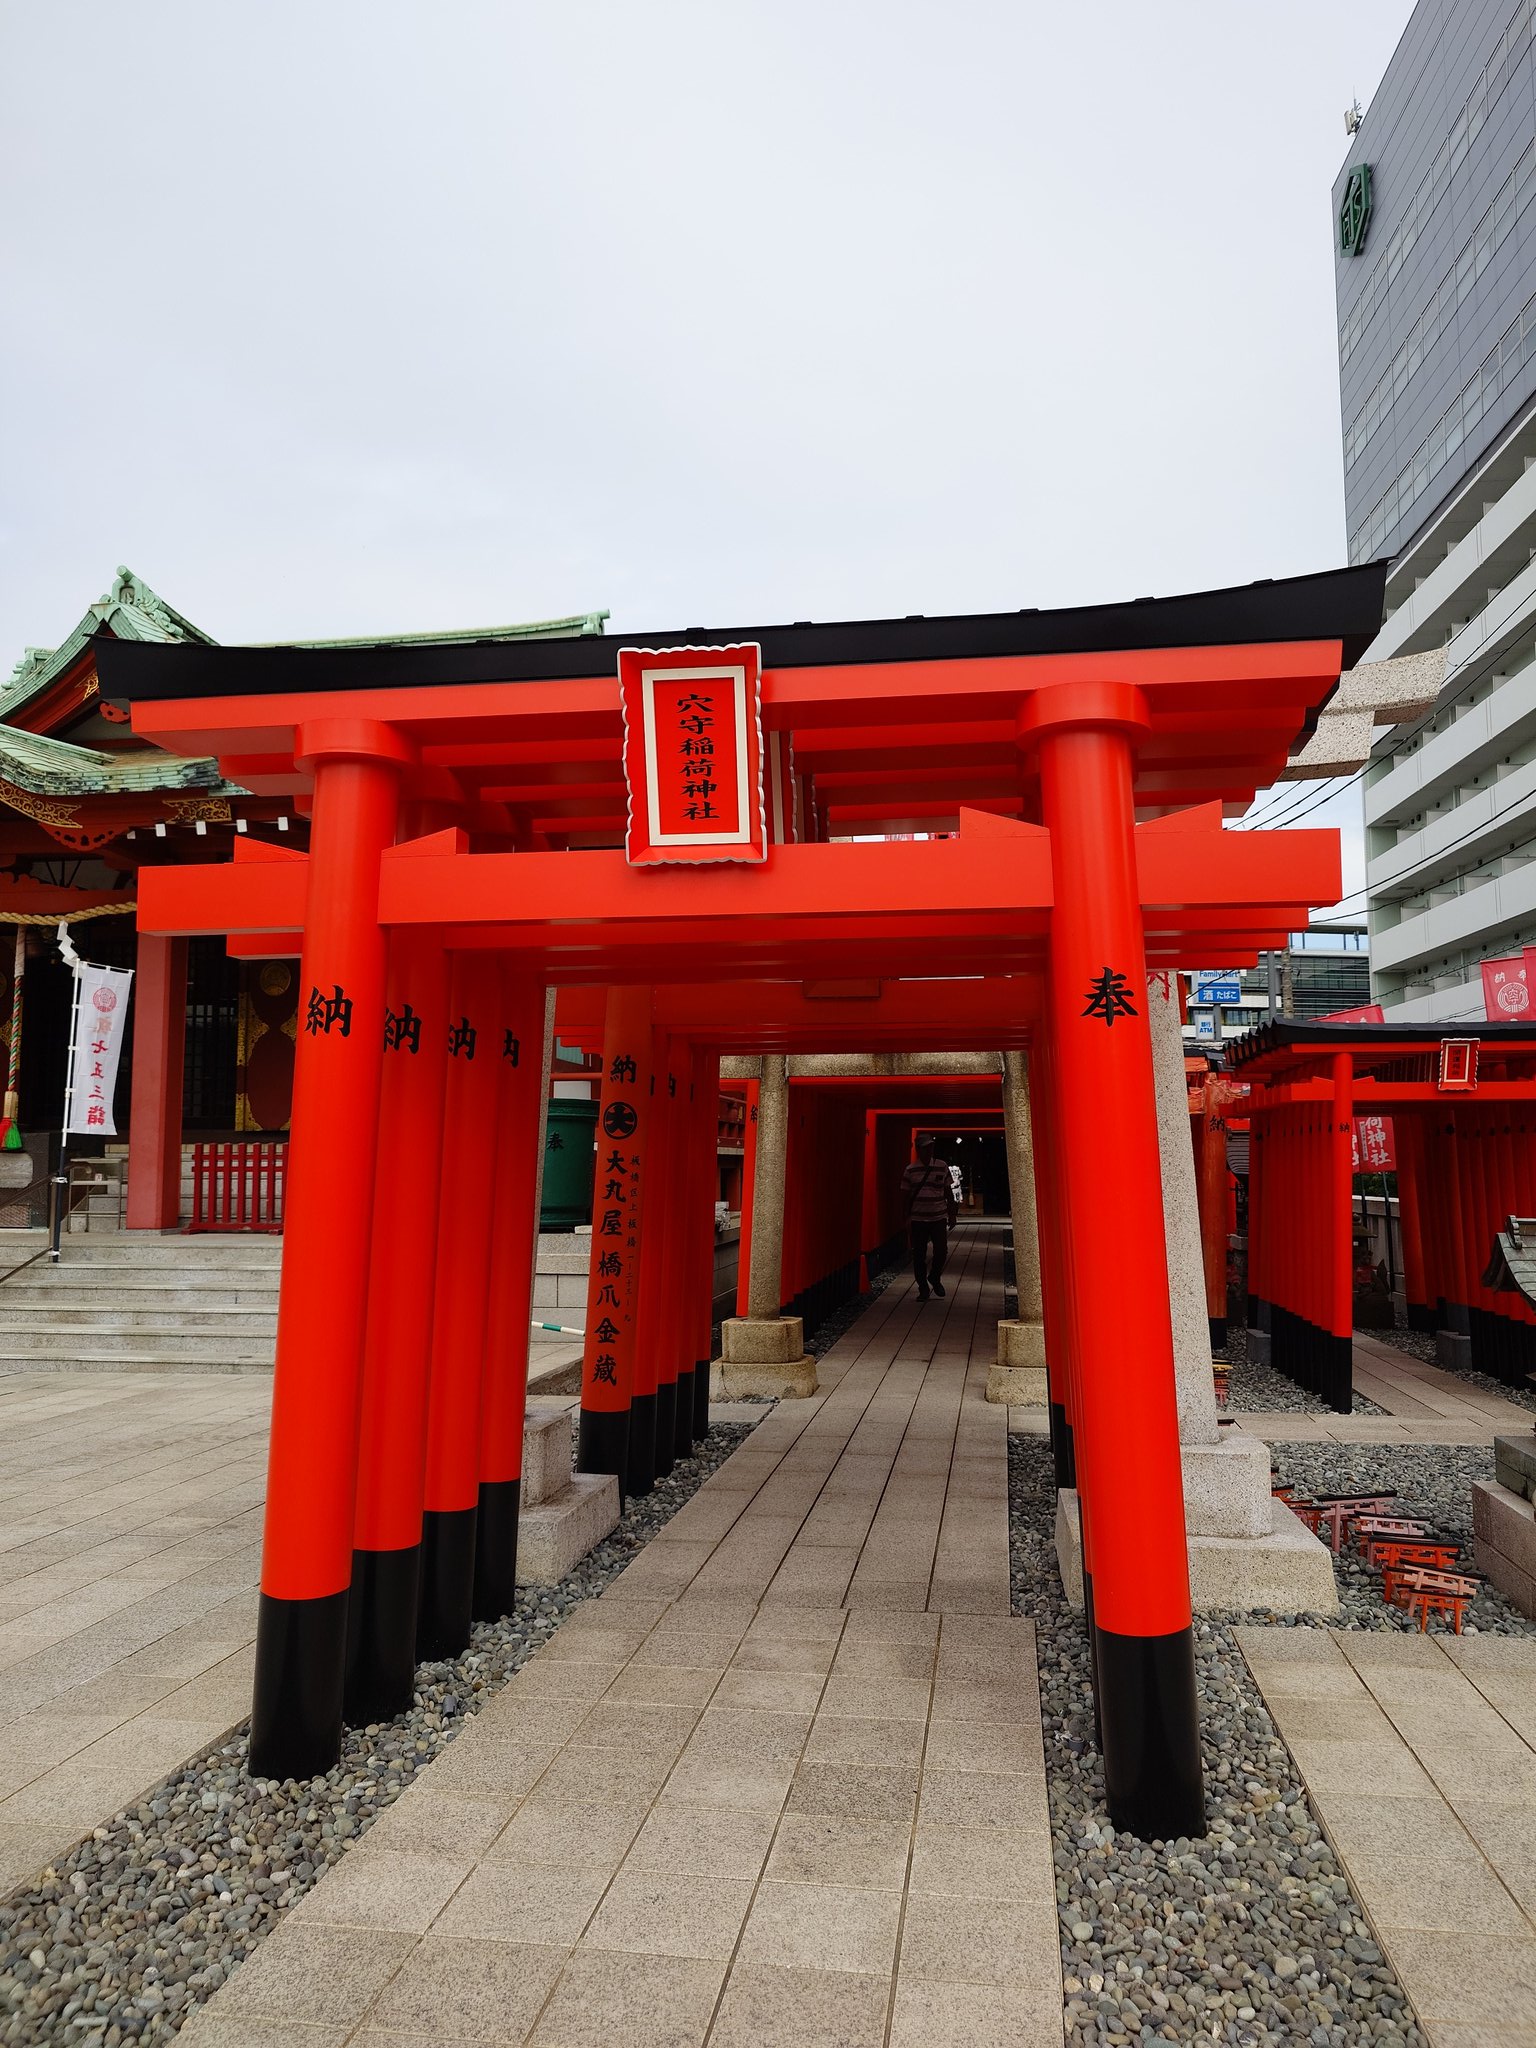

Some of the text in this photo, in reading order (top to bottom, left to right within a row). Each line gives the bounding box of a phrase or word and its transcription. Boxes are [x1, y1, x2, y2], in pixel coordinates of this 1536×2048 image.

[677, 693, 721, 821] 穴守稲荷神社
[1080, 966, 1140, 1028] 奉
[1203, 989, 1239, 1001] 酒 たばこ
[304, 984, 354, 1038] 納
[384, 1003, 423, 1055] 納
[609, 1055, 637, 1084] 納
[1209, 1115, 1225, 1133] 納
[1339, 1121, 1350, 1133] 納
[546, 1130, 564, 1153] 奉
